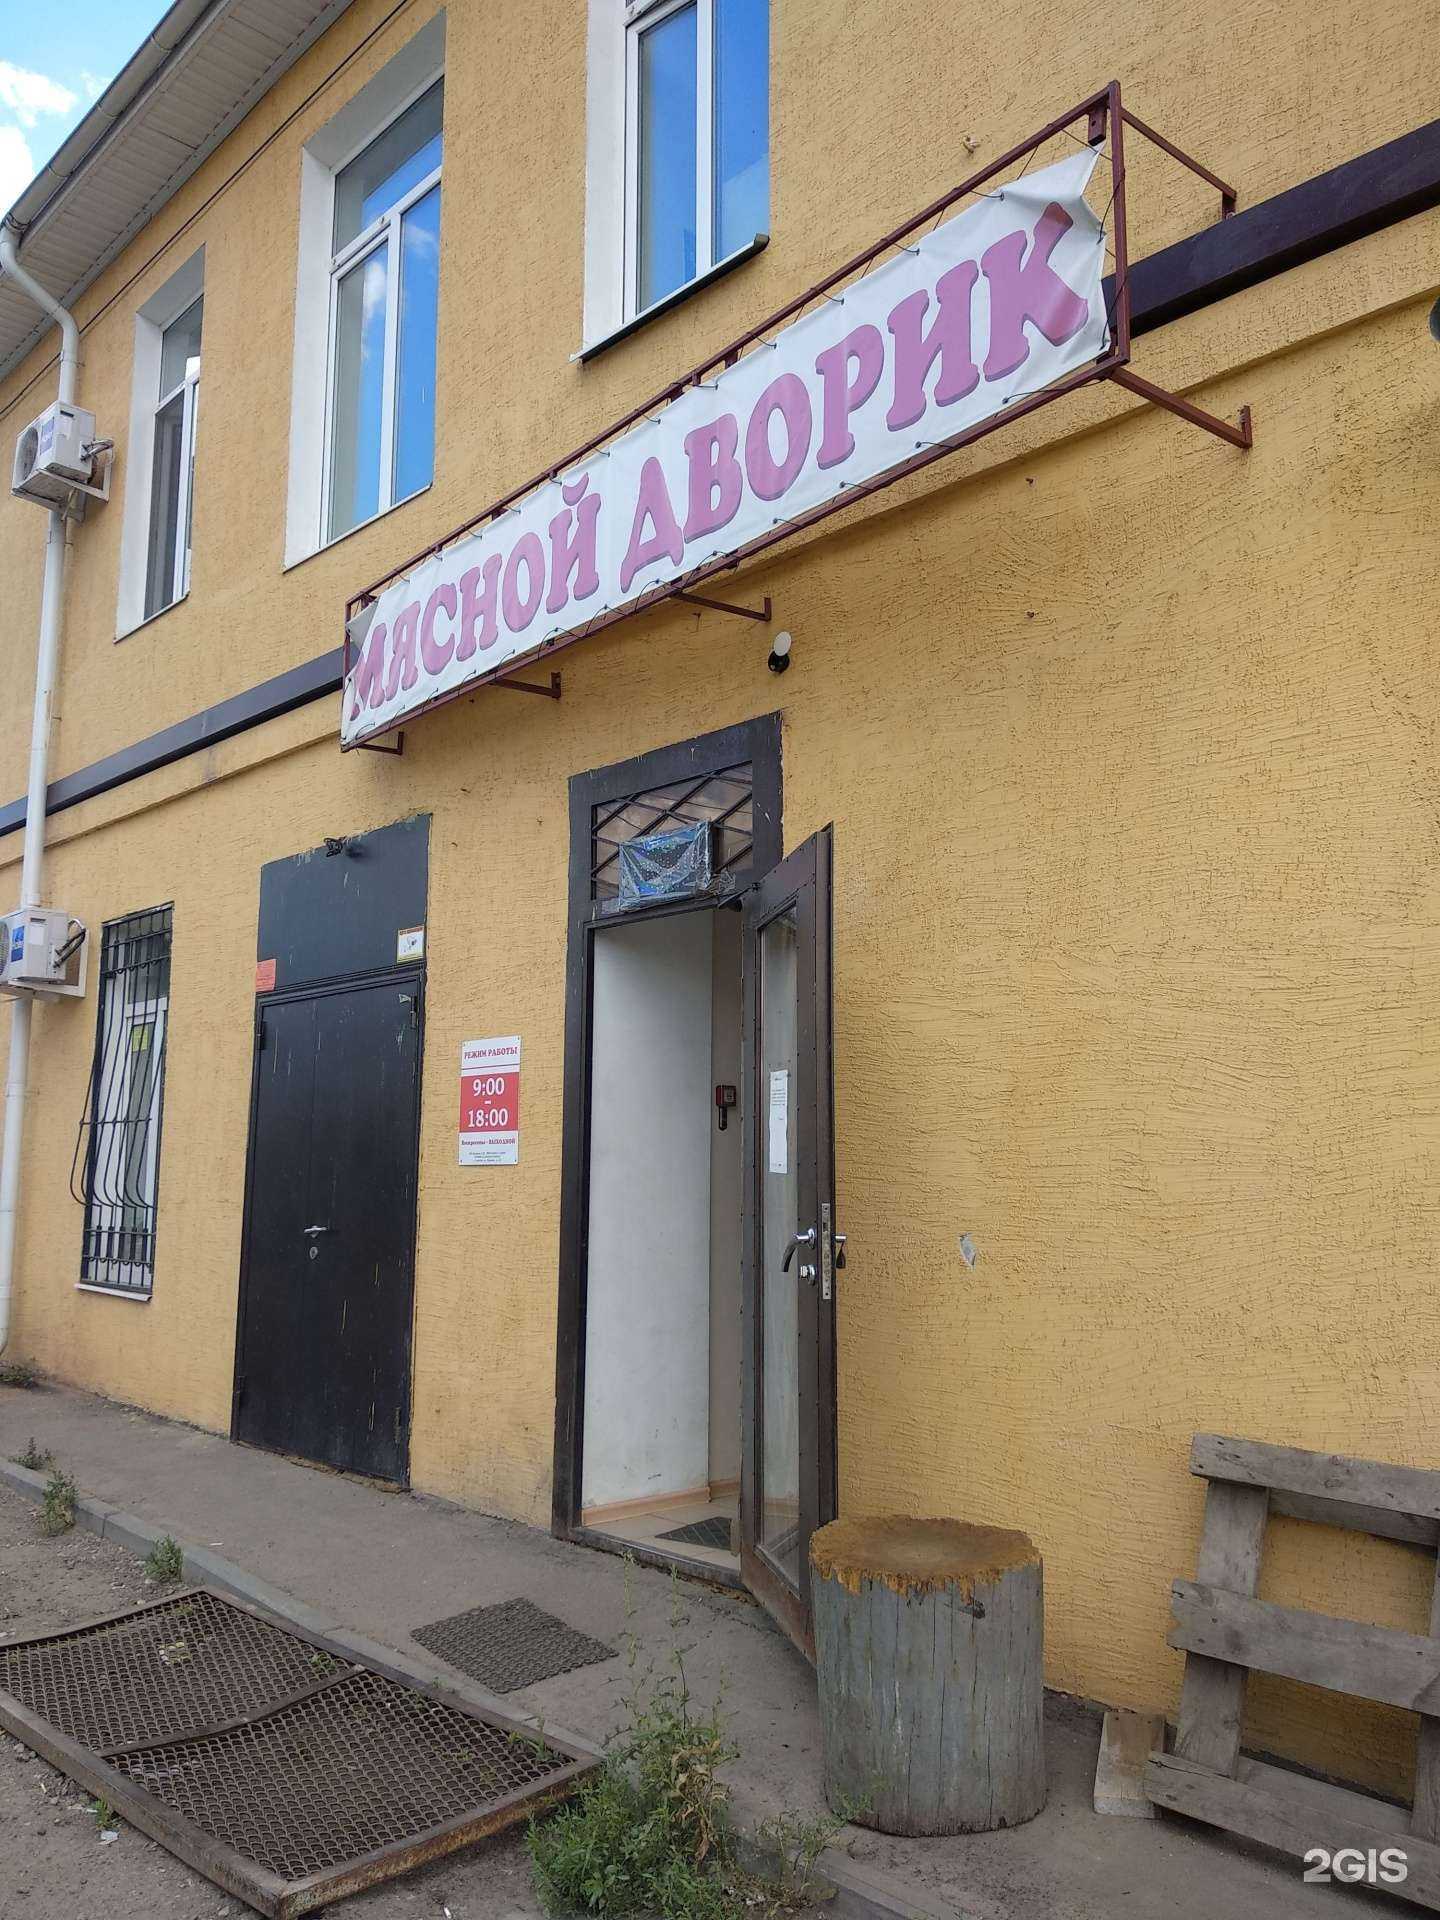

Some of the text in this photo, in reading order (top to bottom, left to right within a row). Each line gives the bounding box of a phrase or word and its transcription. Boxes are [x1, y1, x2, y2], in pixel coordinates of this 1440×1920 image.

[350, 201, 1089, 720] МЯСНОЙ ДВОРИК
[464, 1046, 518, 1060] РЕЖИМ РАБОТЫ
[473, 1077, 505, 1097] 9:00
[468, 1108, 509, 1128] 18:00
